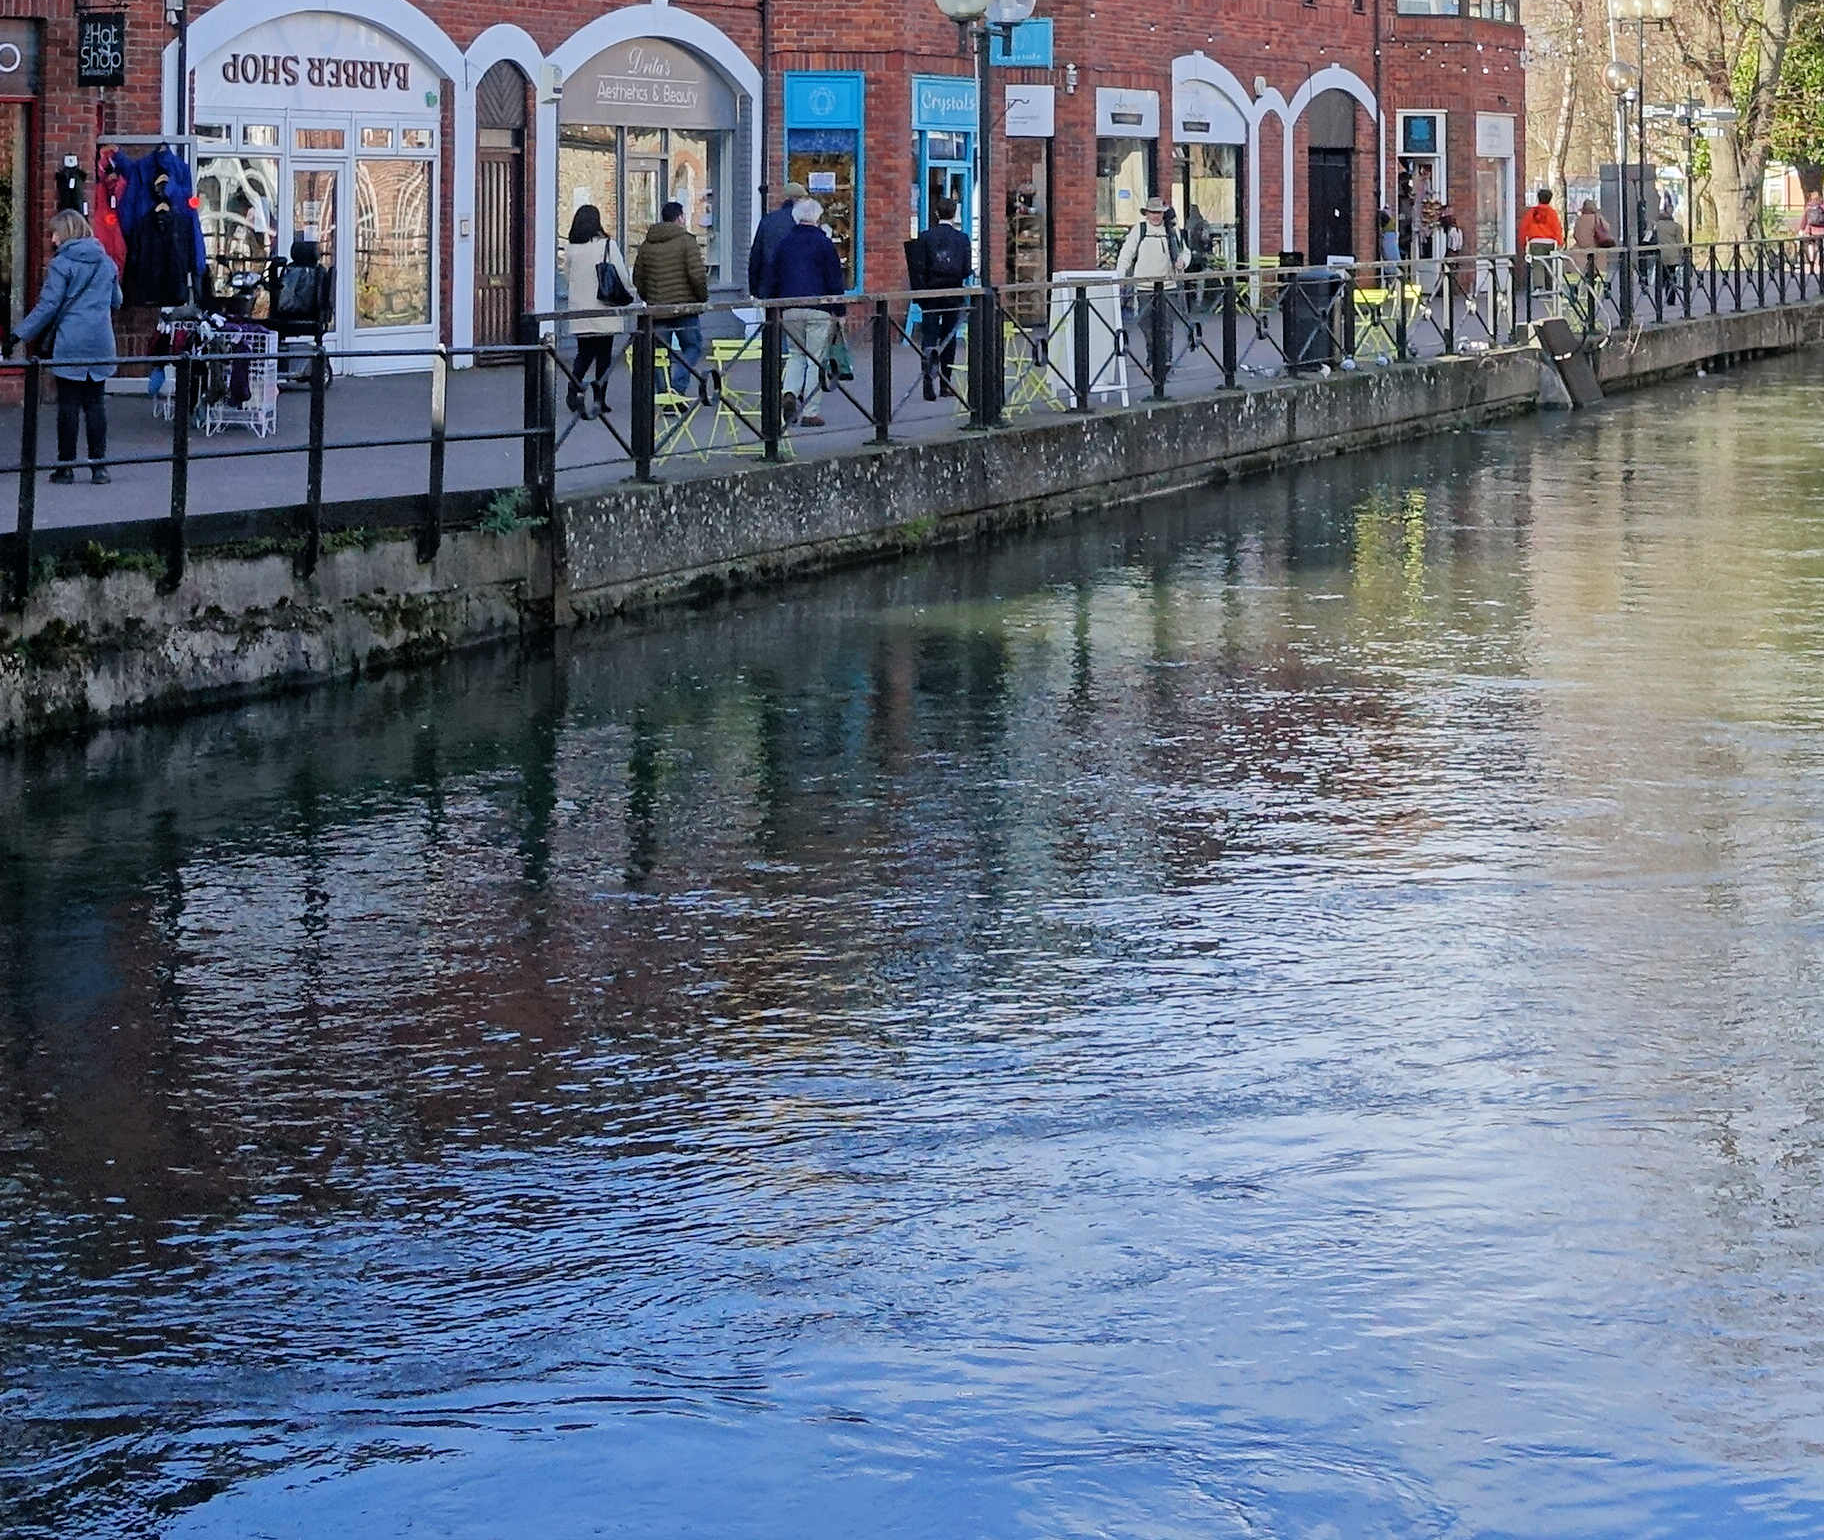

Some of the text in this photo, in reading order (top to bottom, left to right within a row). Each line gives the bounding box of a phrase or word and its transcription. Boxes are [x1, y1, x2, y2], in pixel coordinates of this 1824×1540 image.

[80, 46, 122, 75] Shop
[222, 53, 410, 91] BARBER SHOP
[597, 81, 698, 108] Aesthetics & Beauty
[920, 91, 976, 116] Crystals
